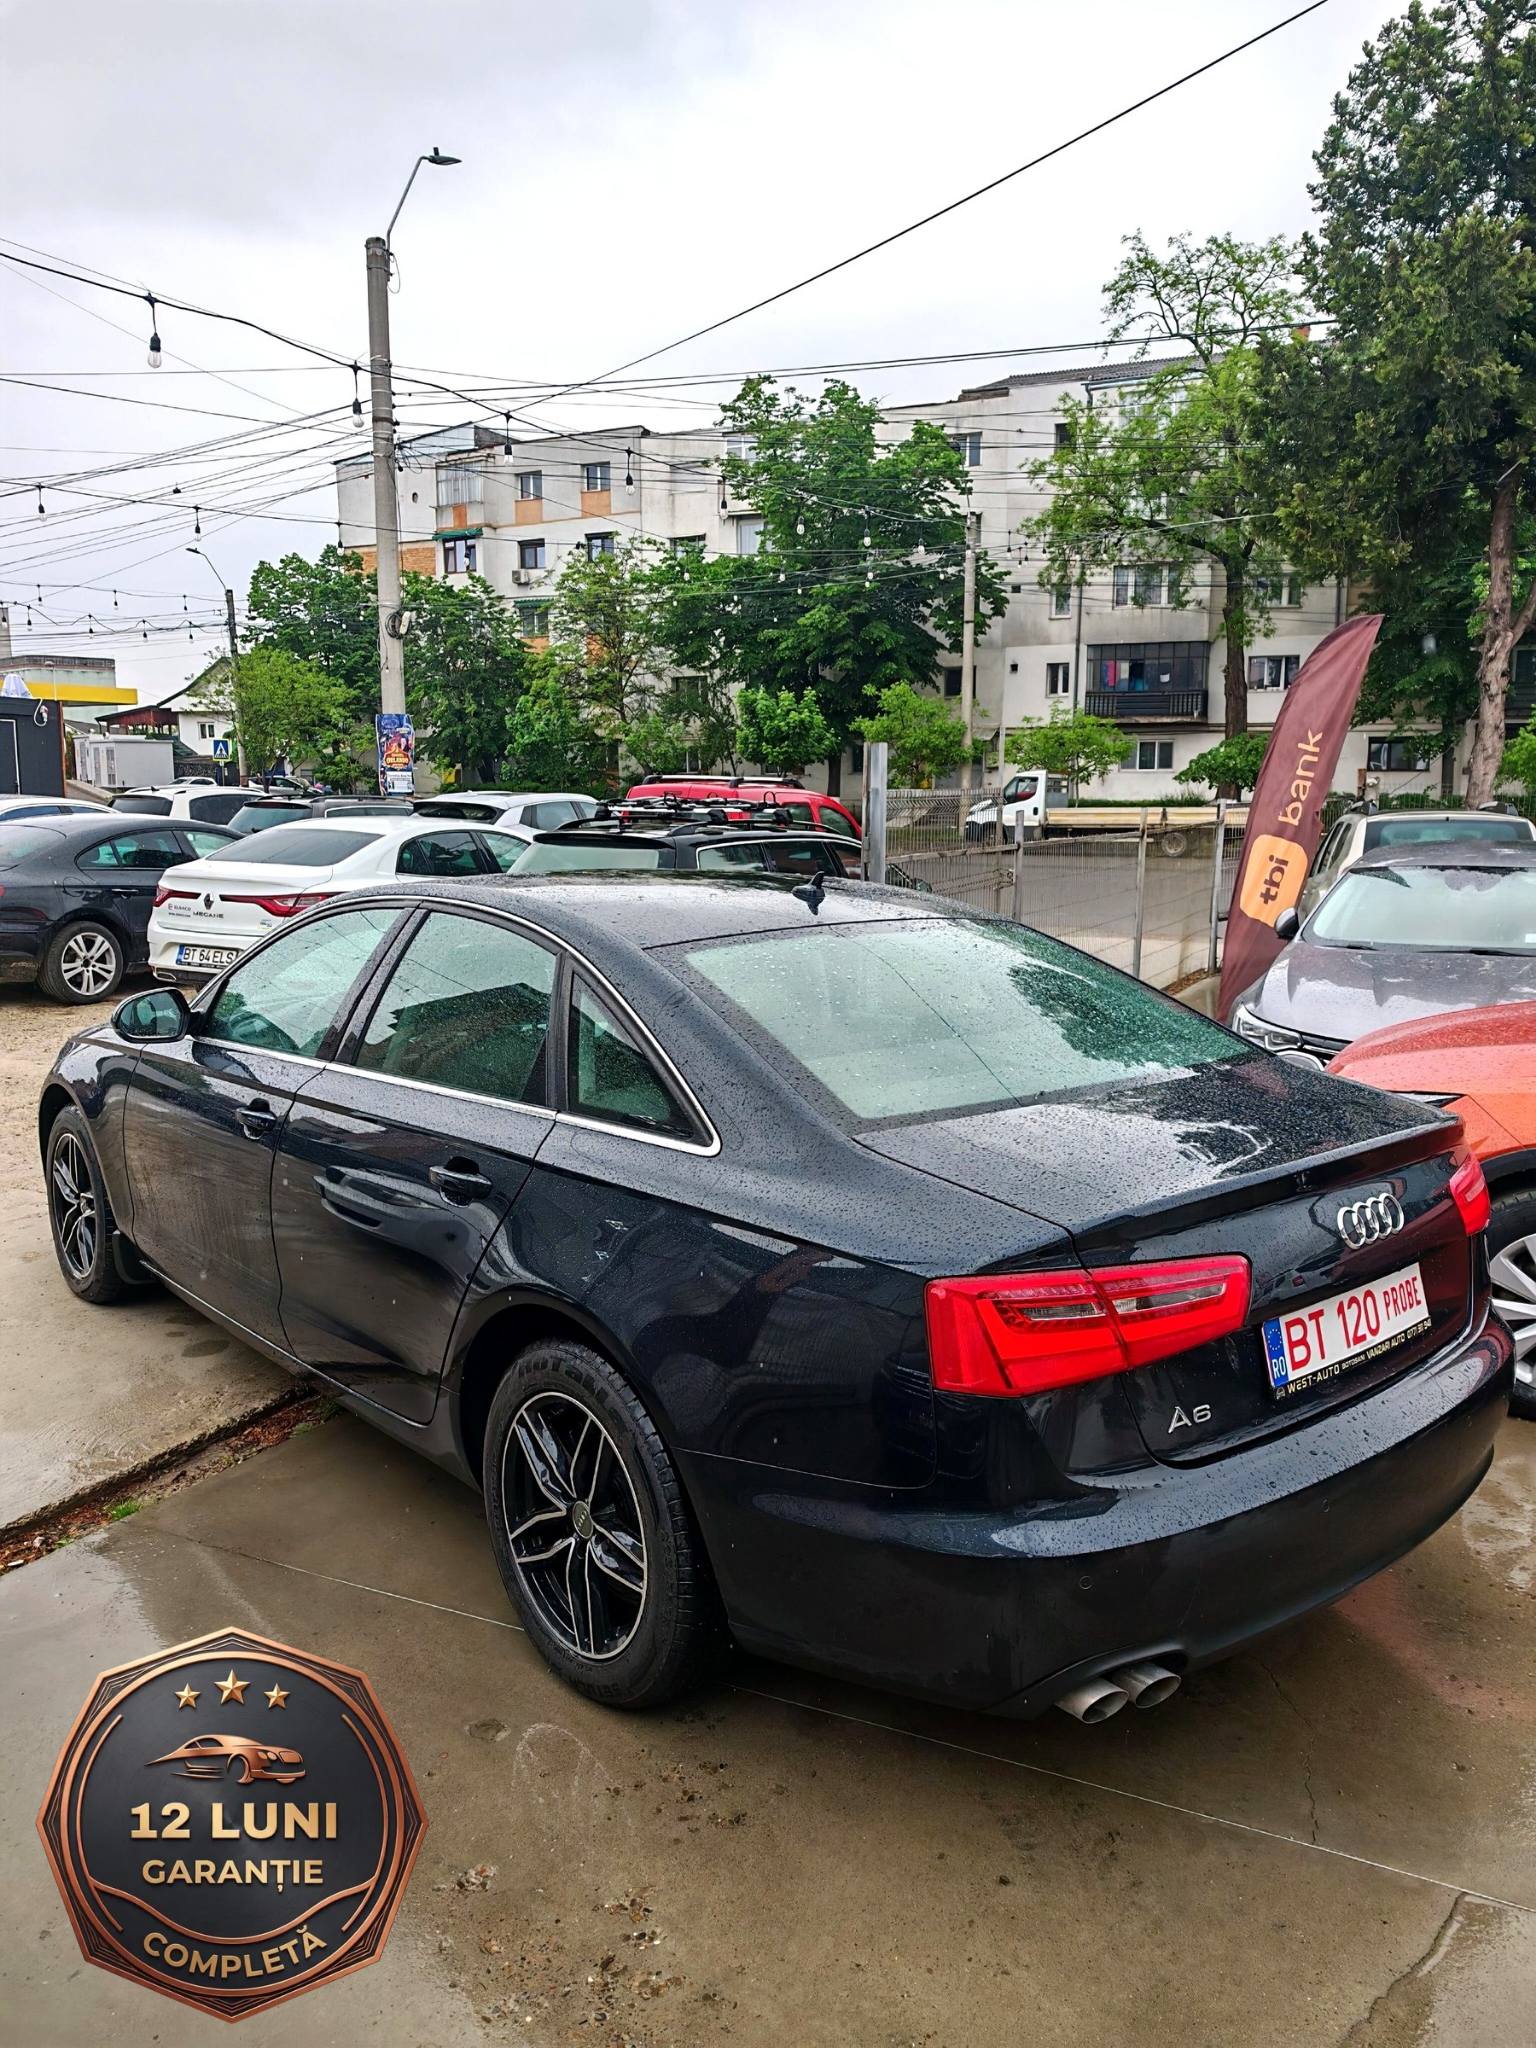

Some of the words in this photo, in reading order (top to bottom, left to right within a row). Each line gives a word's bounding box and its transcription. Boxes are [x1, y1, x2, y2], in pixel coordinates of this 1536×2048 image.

[1278, 728, 1323, 826] bank
[1259, 854, 1289, 905] tbi
[193, 911, 224, 919] MEGANE
[184, 948, 197, 961] BT
[199, 949, 210, 962] 64
[212, 951, 234, 964] ELS
[1284, 1311, 1327, 1371] BT
[1337, 1289, 1380, 1349] 120
[1383, 1275, 1422, 1321] PROBE
[1272, 1357, 1286, 1379] RO
[1287, 1364, 1341, 1394] WEST-AUTO
[1391, 1333, 1406, 1347] AUTO
[1167, 1403, 1212, 1434] A6
